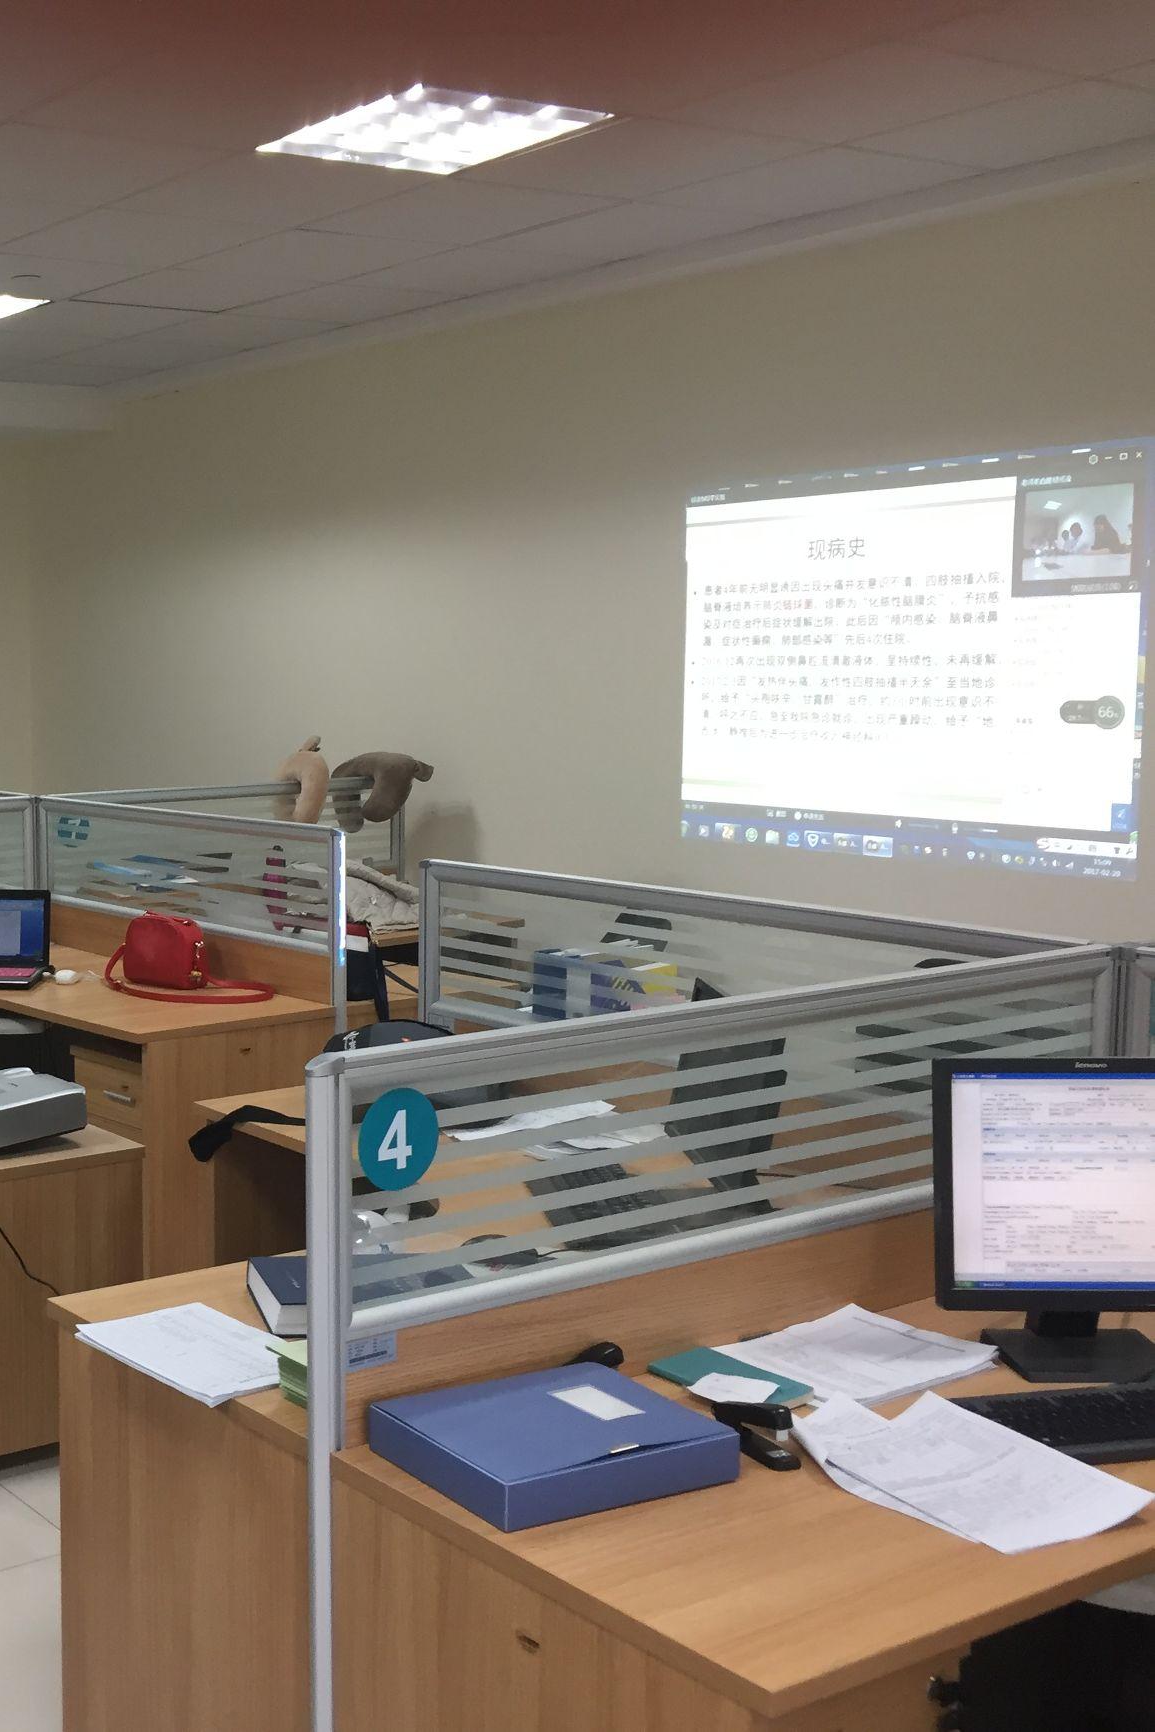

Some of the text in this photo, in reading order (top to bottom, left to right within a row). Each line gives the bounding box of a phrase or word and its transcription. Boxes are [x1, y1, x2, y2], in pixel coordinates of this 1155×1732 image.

[807, 536, 866, 560] 现病史
[378, 1109, 413, 1170] 4
